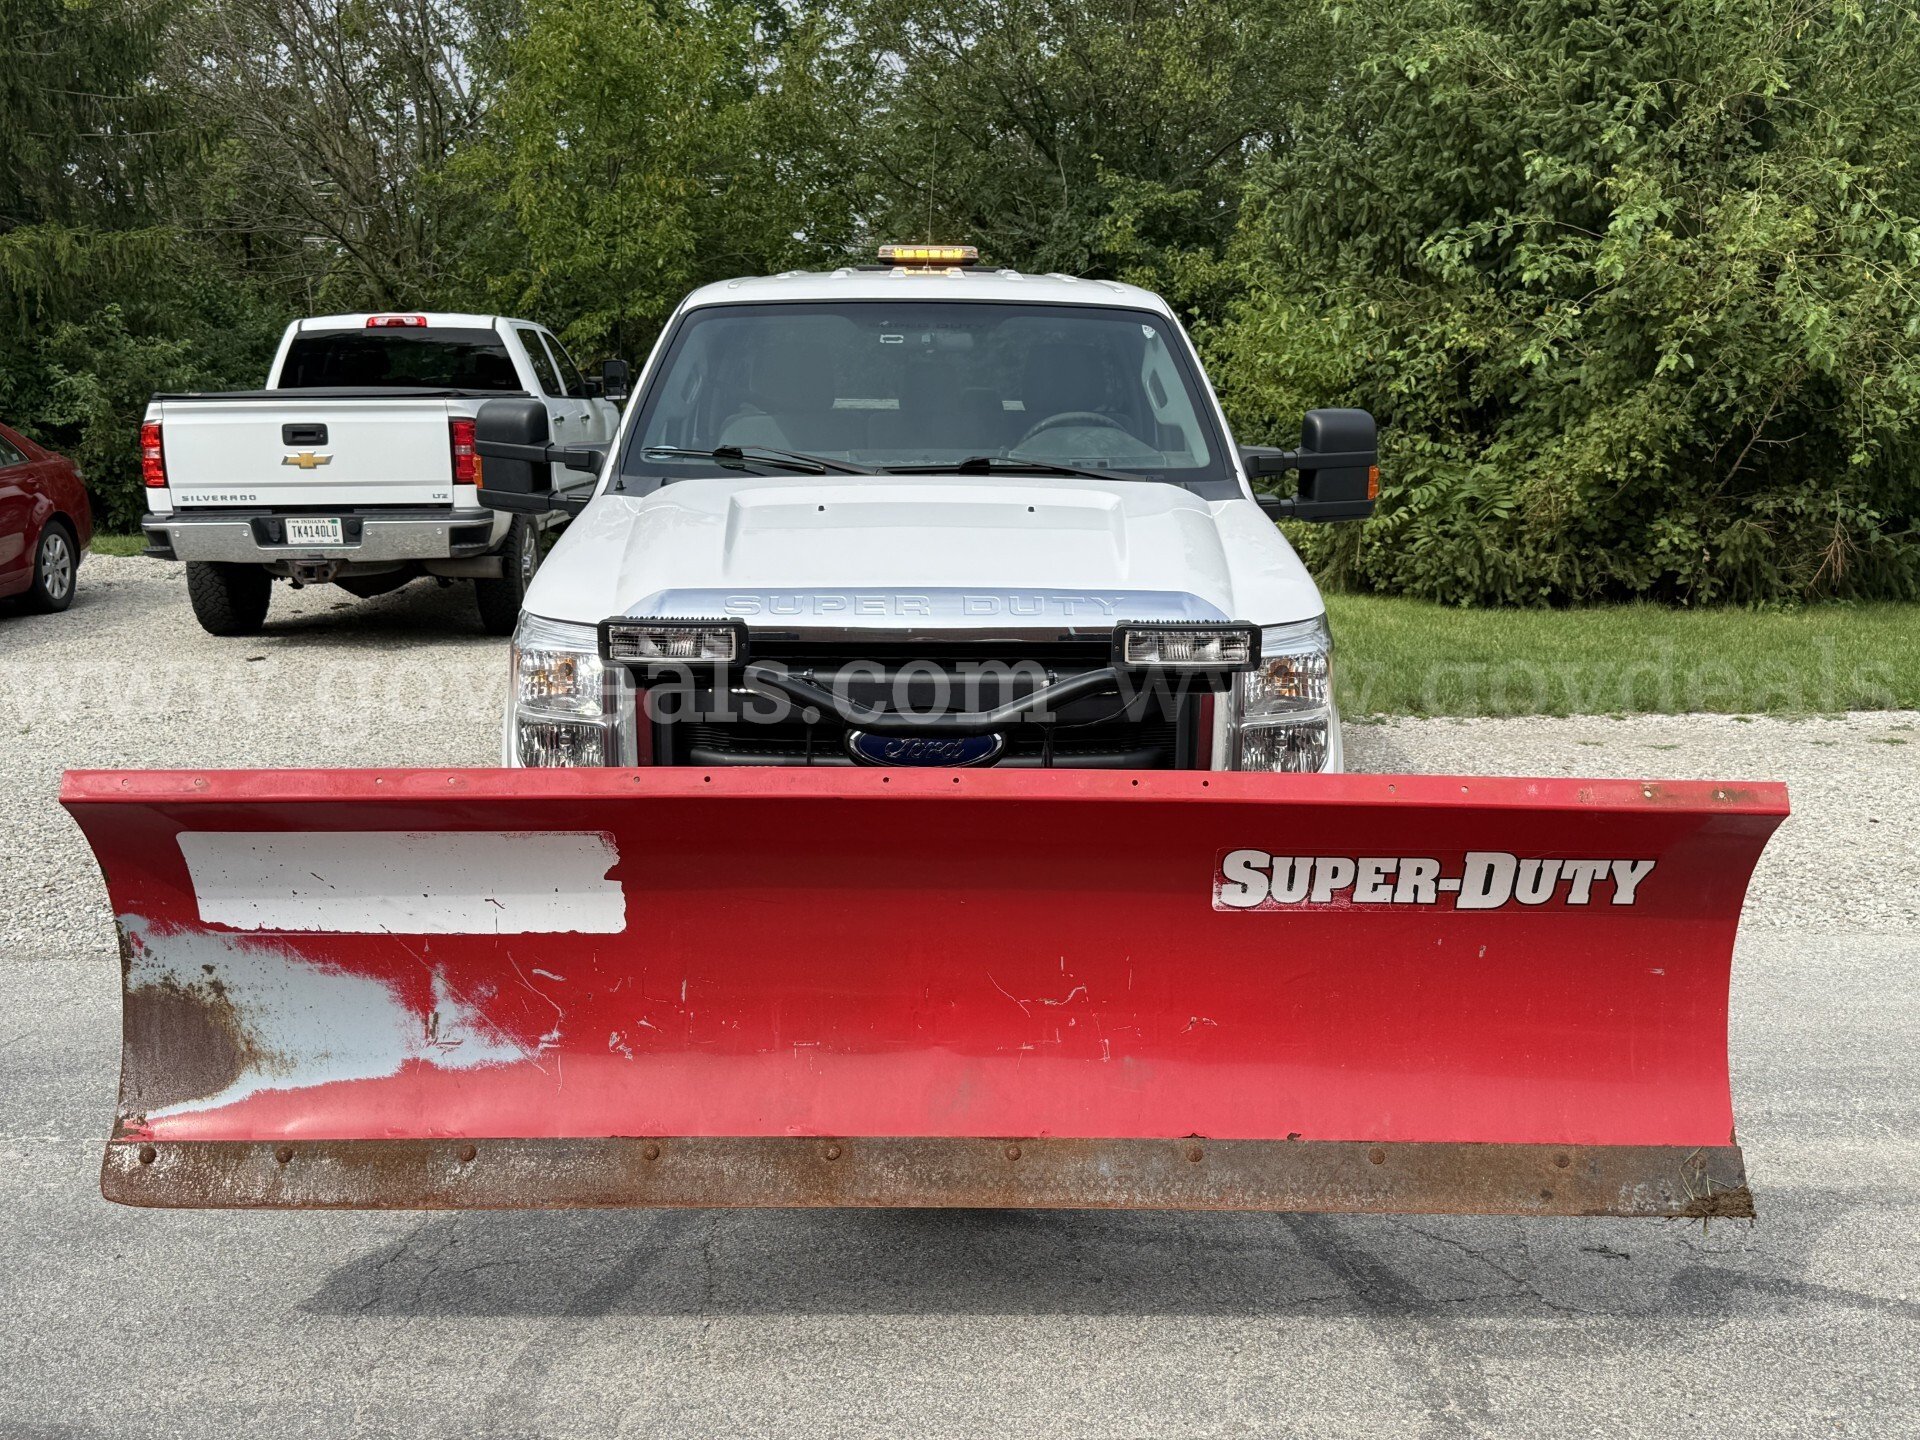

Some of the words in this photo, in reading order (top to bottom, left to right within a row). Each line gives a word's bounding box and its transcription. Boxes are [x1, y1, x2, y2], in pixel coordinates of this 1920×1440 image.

[181, 494, 257, 502] SILVERADO
[724, 594, 932, 616] SUPER
[962, 594, 1126, 617] DUTY
[884, 737, 965, 759] Ford
[1221, 848, 1656, 910] SUPER-DUTY
